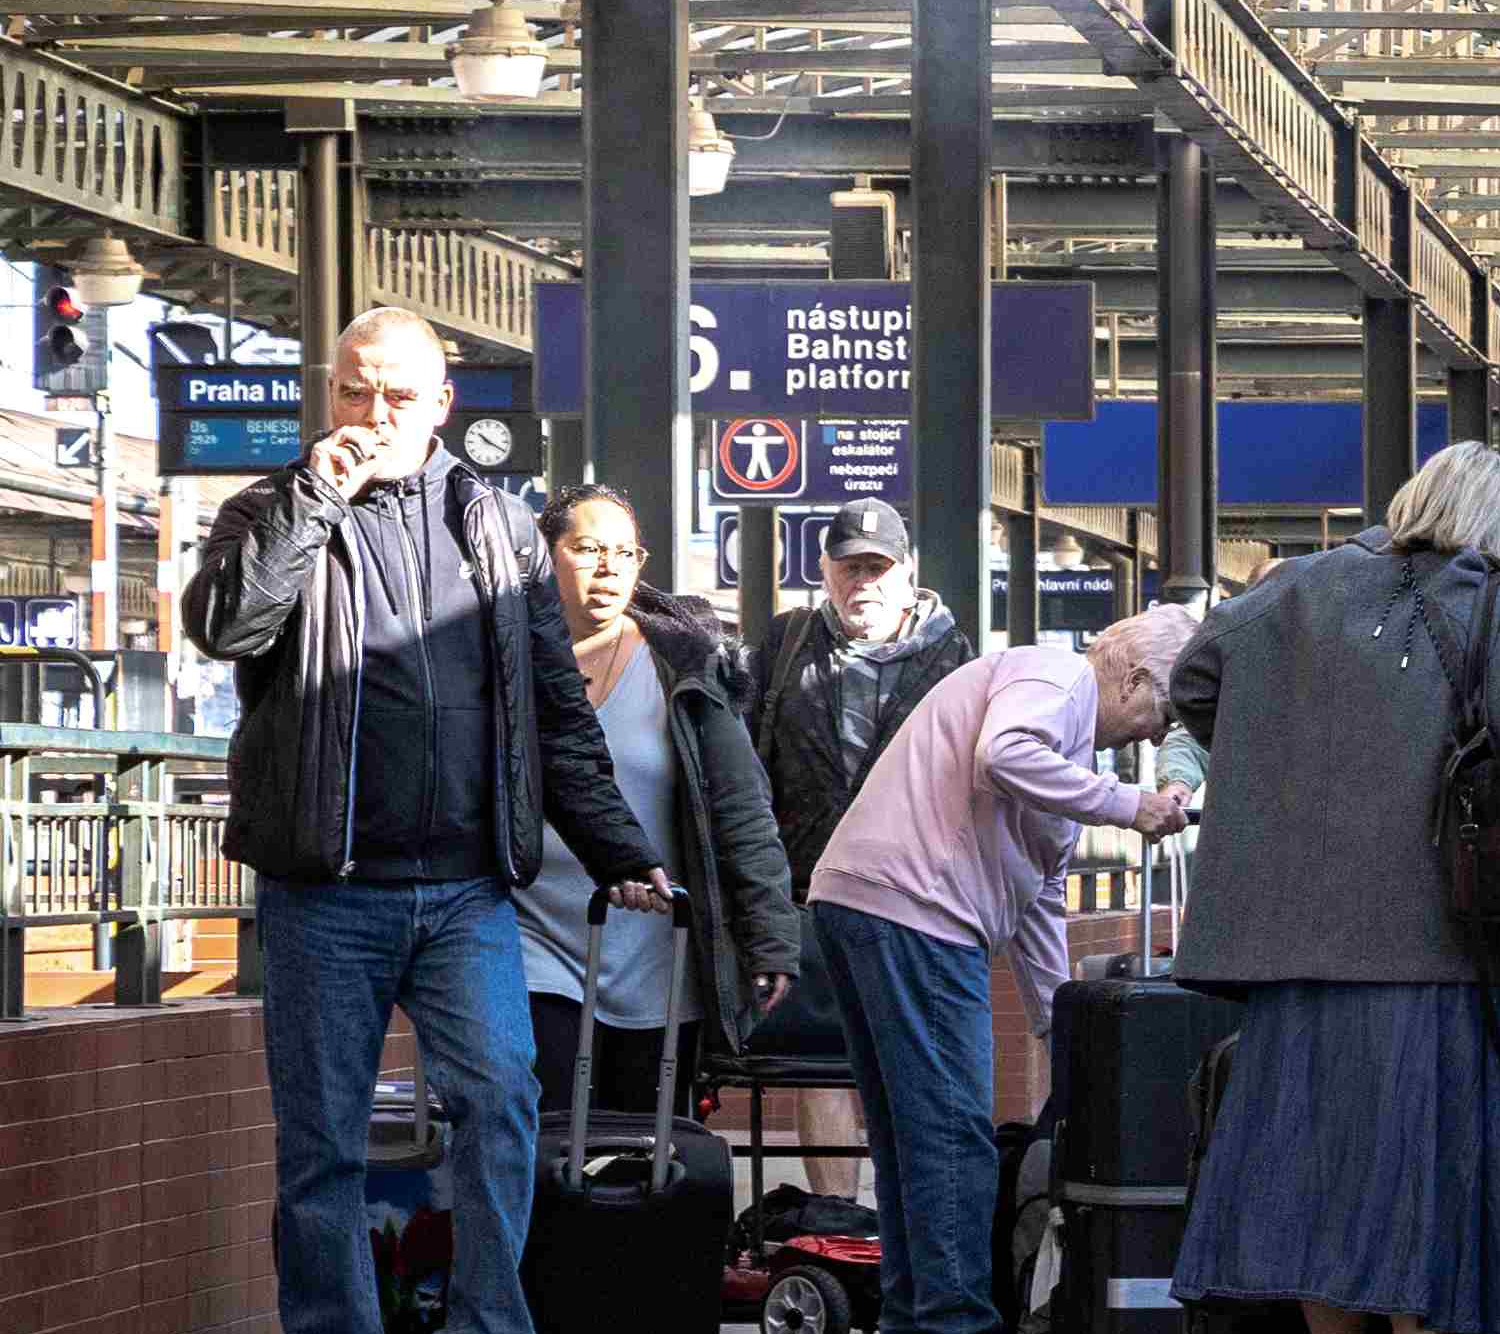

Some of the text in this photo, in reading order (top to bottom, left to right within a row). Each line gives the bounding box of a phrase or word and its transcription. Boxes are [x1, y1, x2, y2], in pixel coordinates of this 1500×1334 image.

[786, 302, 912, 337] nástupi
[787, 333, 911, 360] Bahnst
[189, 379, 264, 401] Praha
